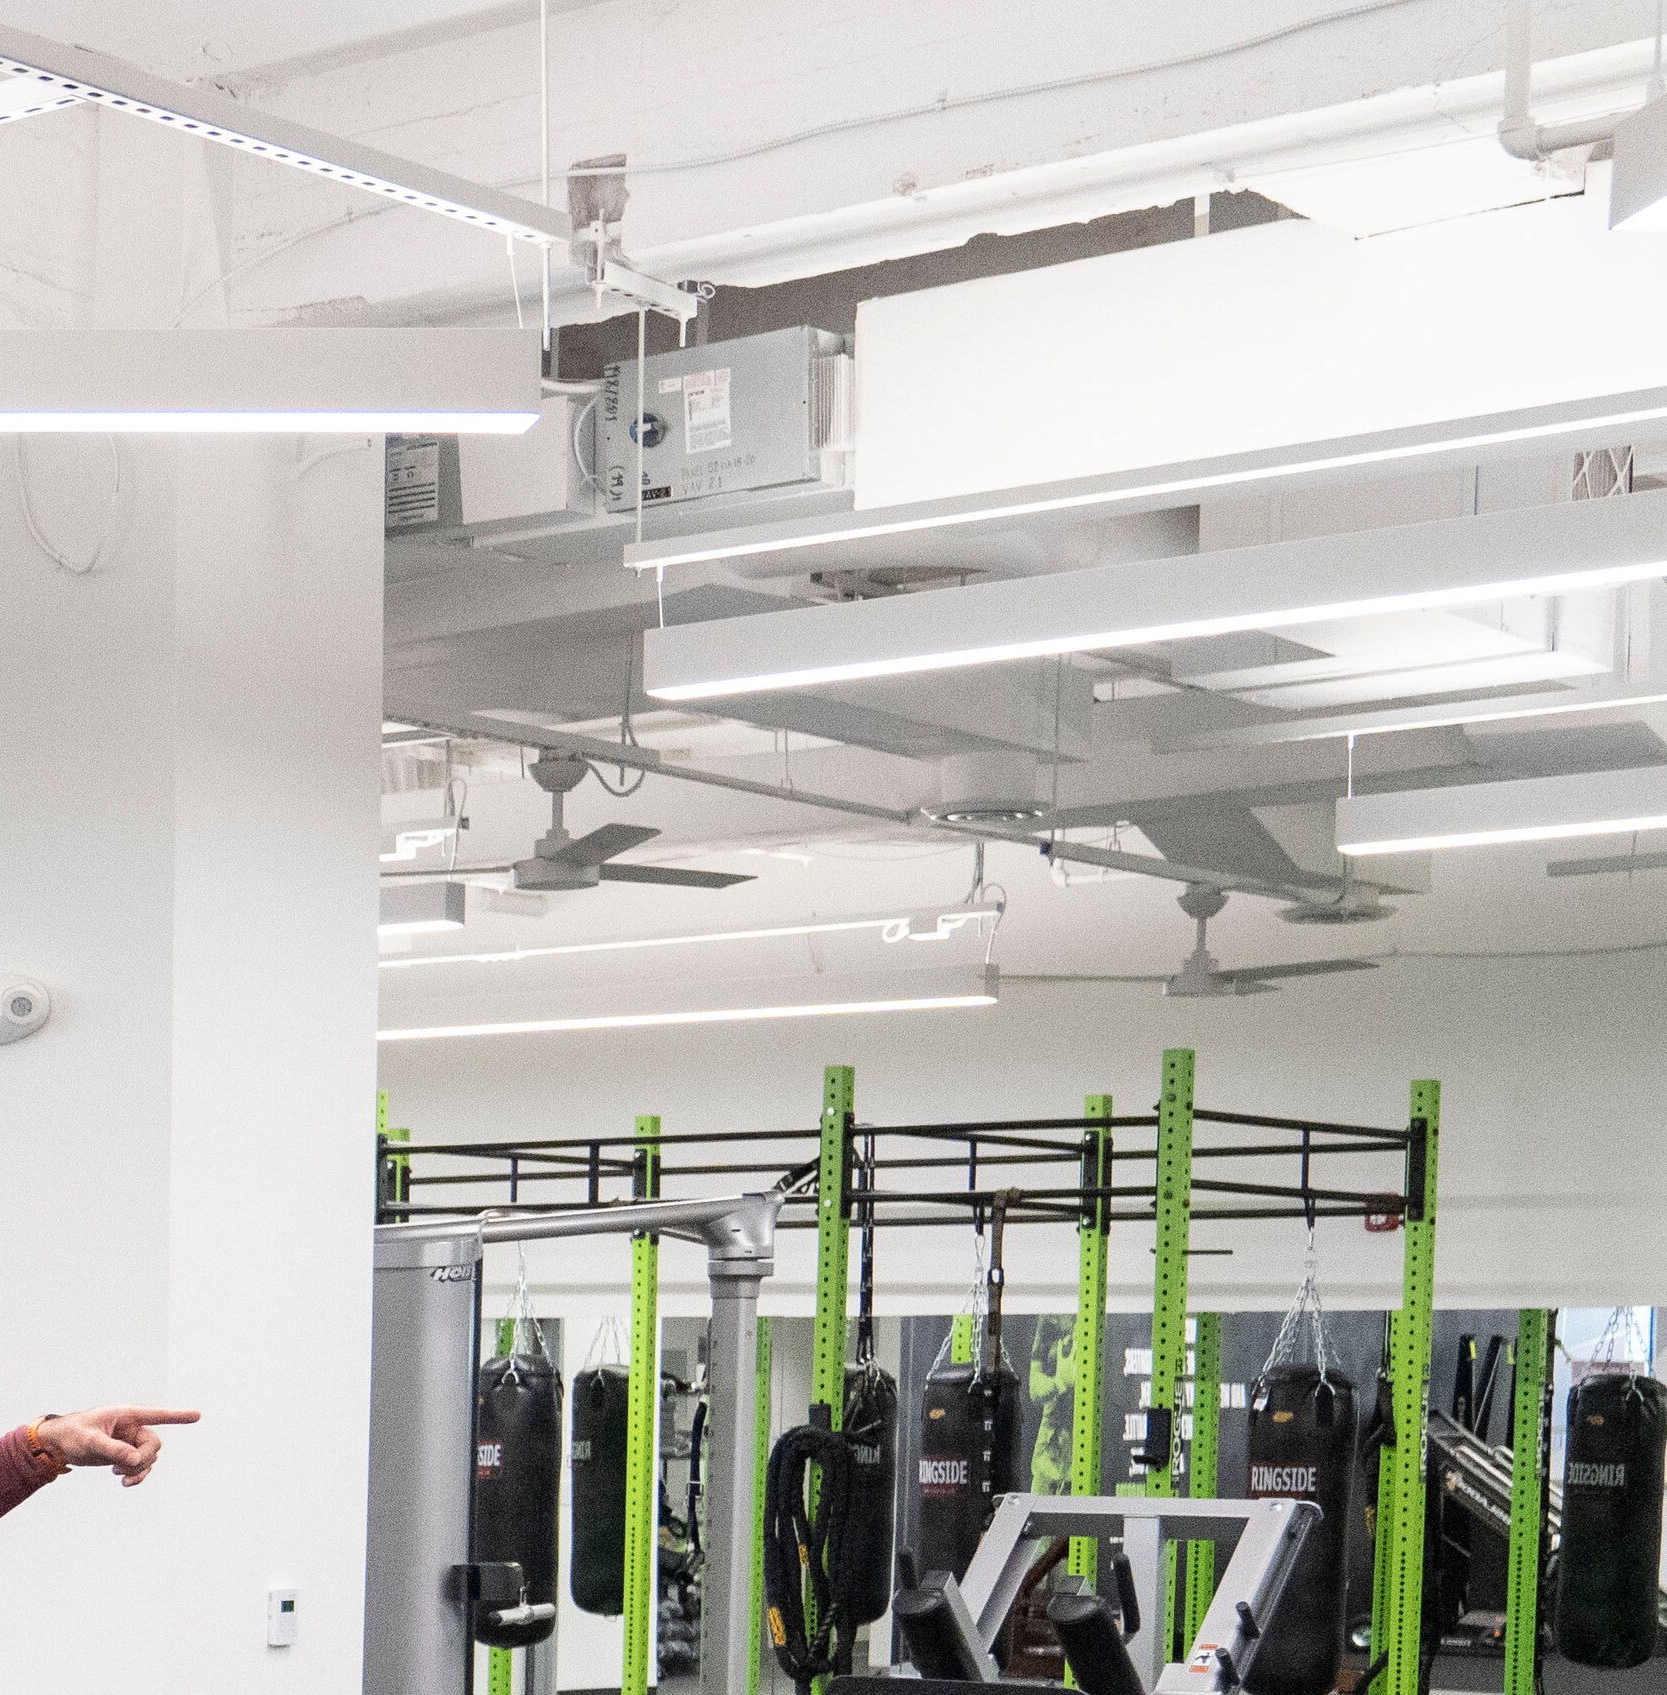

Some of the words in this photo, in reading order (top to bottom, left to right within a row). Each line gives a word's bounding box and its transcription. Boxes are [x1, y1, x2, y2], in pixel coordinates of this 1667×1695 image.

[1171, 1379, 1183, 1477] ROGUE
[477, 1443, 502, 1467] SIDE
[1251, 1466, 1316, 1491] RINGSIDE
